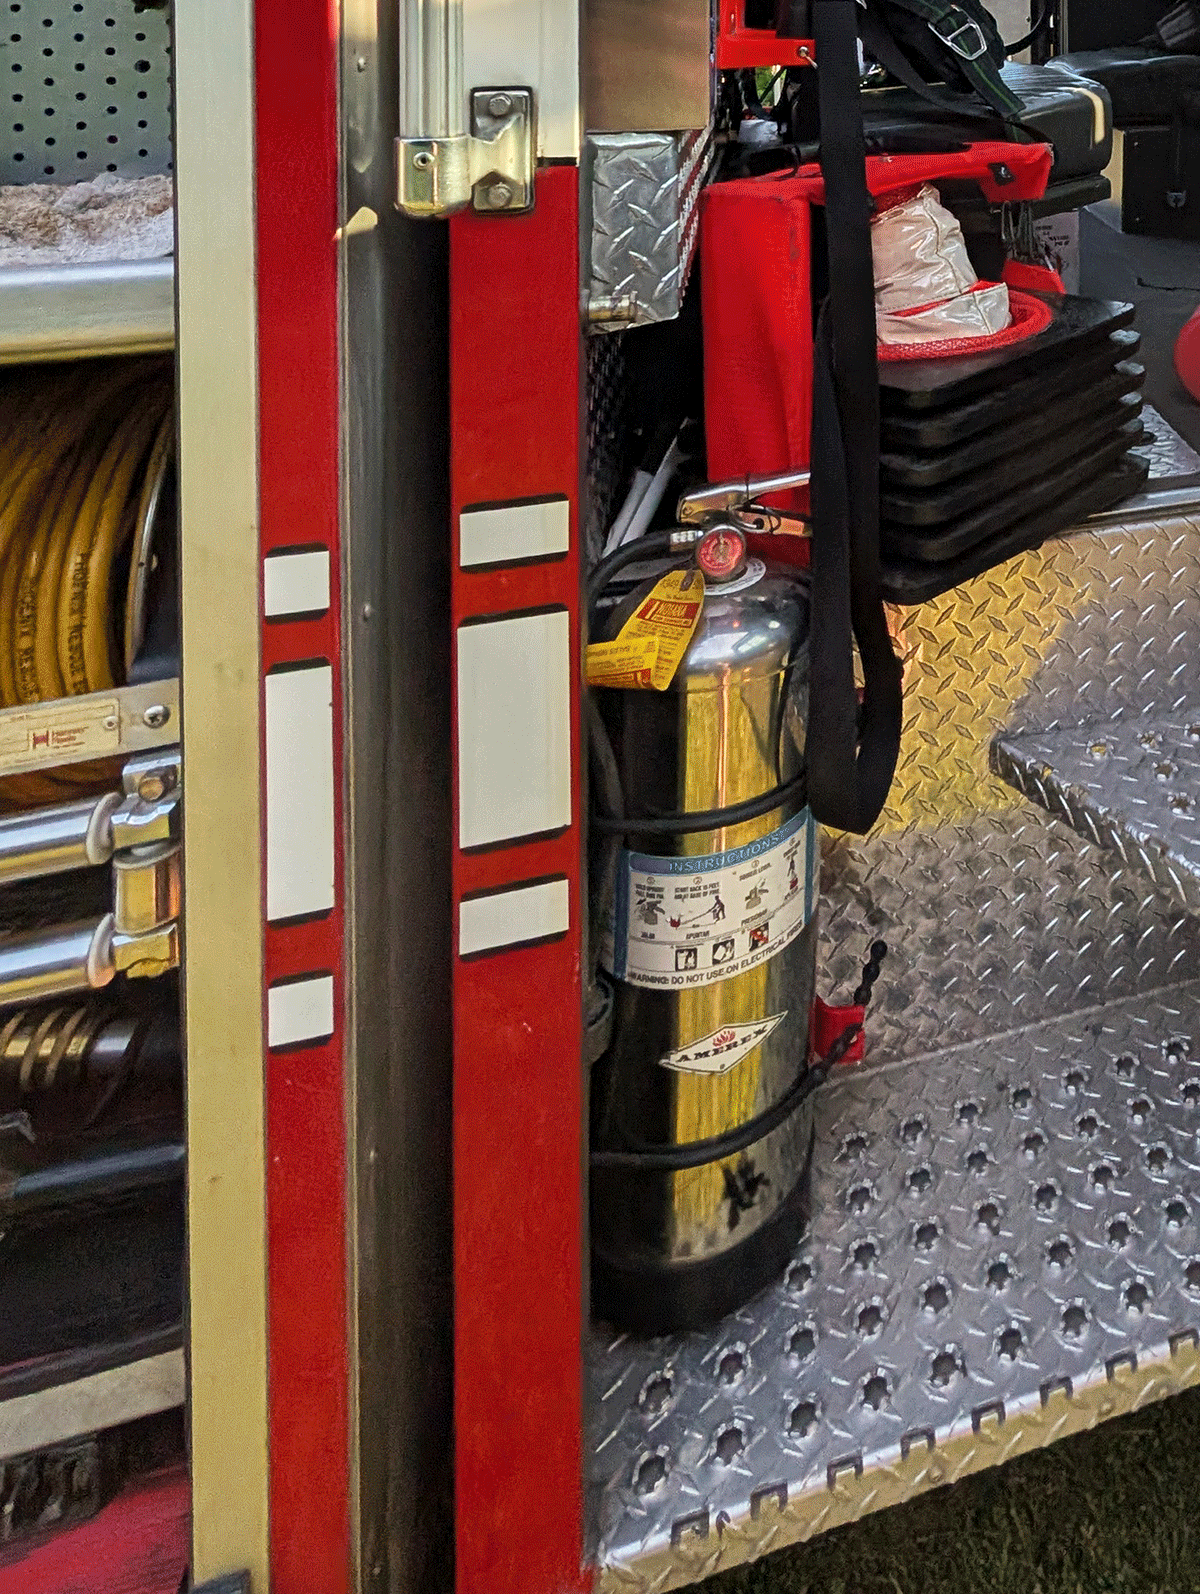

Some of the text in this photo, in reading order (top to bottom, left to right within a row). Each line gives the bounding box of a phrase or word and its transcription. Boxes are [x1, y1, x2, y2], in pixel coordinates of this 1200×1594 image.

[669, 833, 781, 873] INSTRUCTIONS
[671, 976, 685, 984] DO
[686, 973, 704, 983] NOT
[706, 968, 724, 980] USE
[726, 963, 739, 974] ON
[741, 936, 785, 968] ELECTRICAL
[676, 1024, 768, 1062] AMEREX
